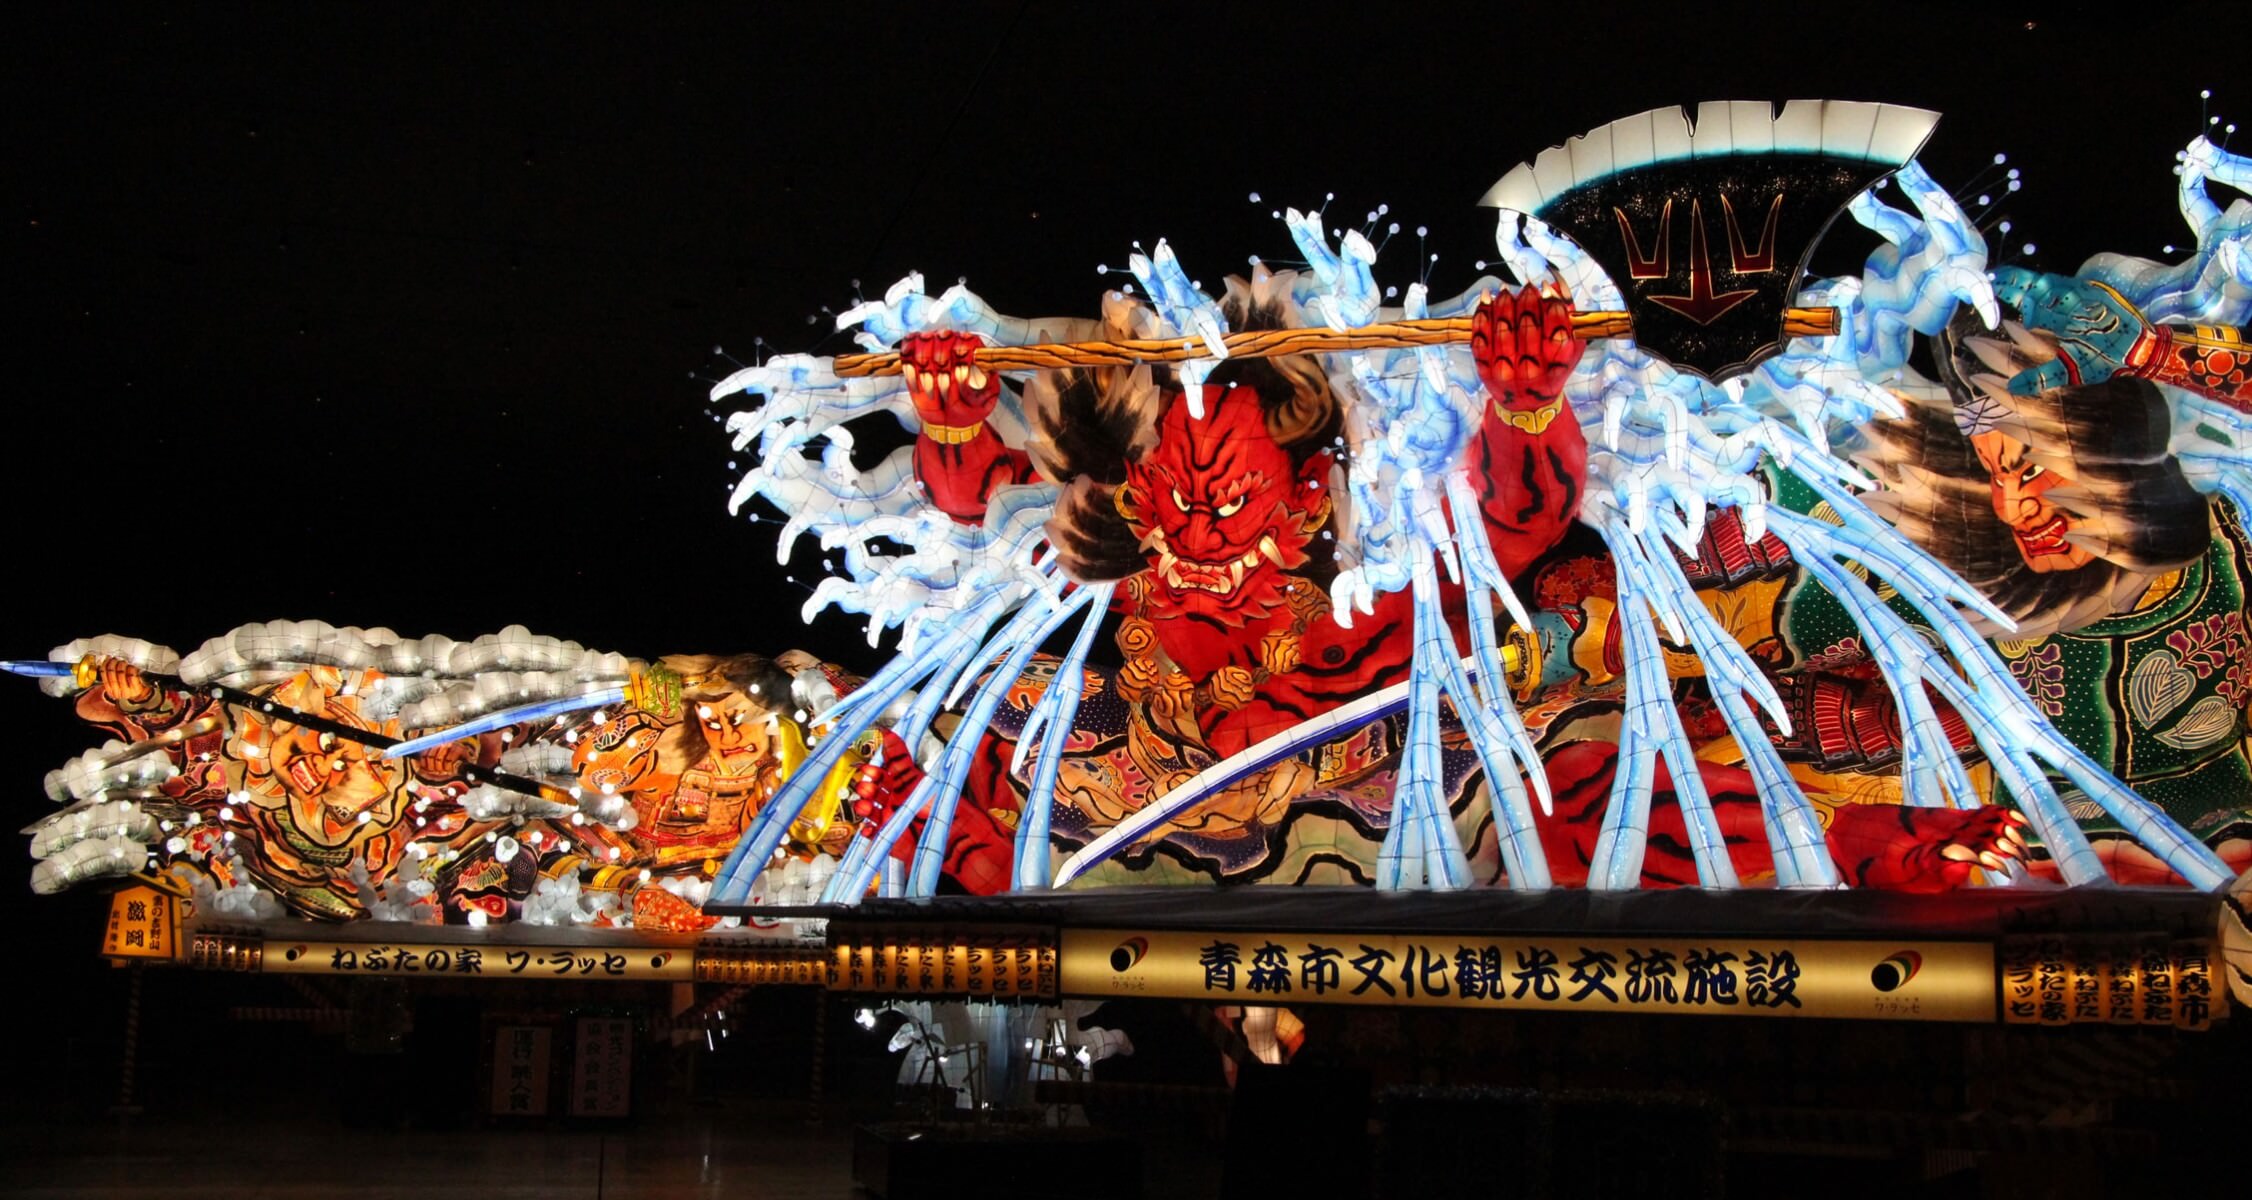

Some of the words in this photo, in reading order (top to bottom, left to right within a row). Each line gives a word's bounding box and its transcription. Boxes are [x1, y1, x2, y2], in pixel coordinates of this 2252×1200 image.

[331, 946, 482, 974] ねぶたの家
[505, 950, 627, 976] ワ・ラッセ
[1199, 939, 1803, 1009] 青森市文化観光交流施設
